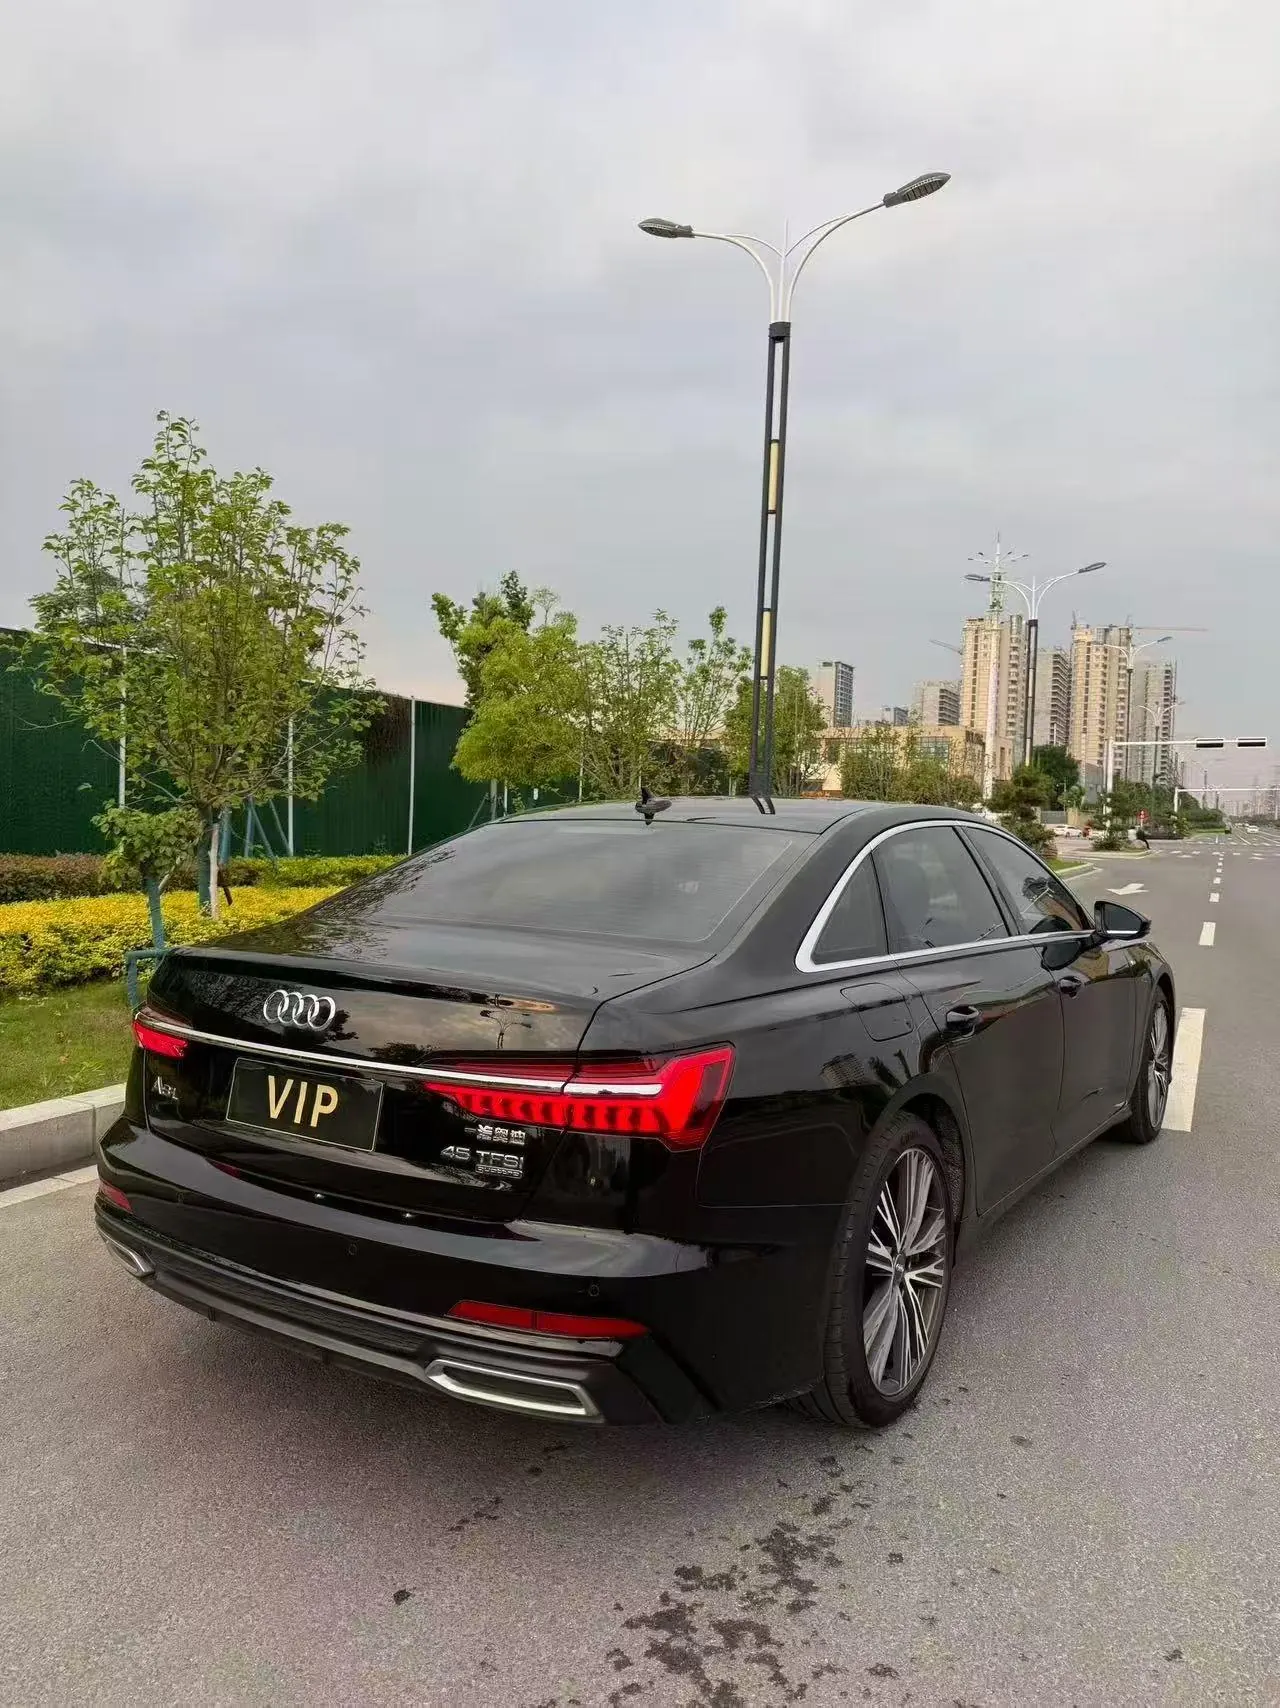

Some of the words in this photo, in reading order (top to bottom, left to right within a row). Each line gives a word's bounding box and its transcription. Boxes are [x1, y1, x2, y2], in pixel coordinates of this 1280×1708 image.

[268, 1075, 339, 1128] VIP
[440, 1145, 471, 1161] 45
[476, 1150, 524, 1169] TFSI
